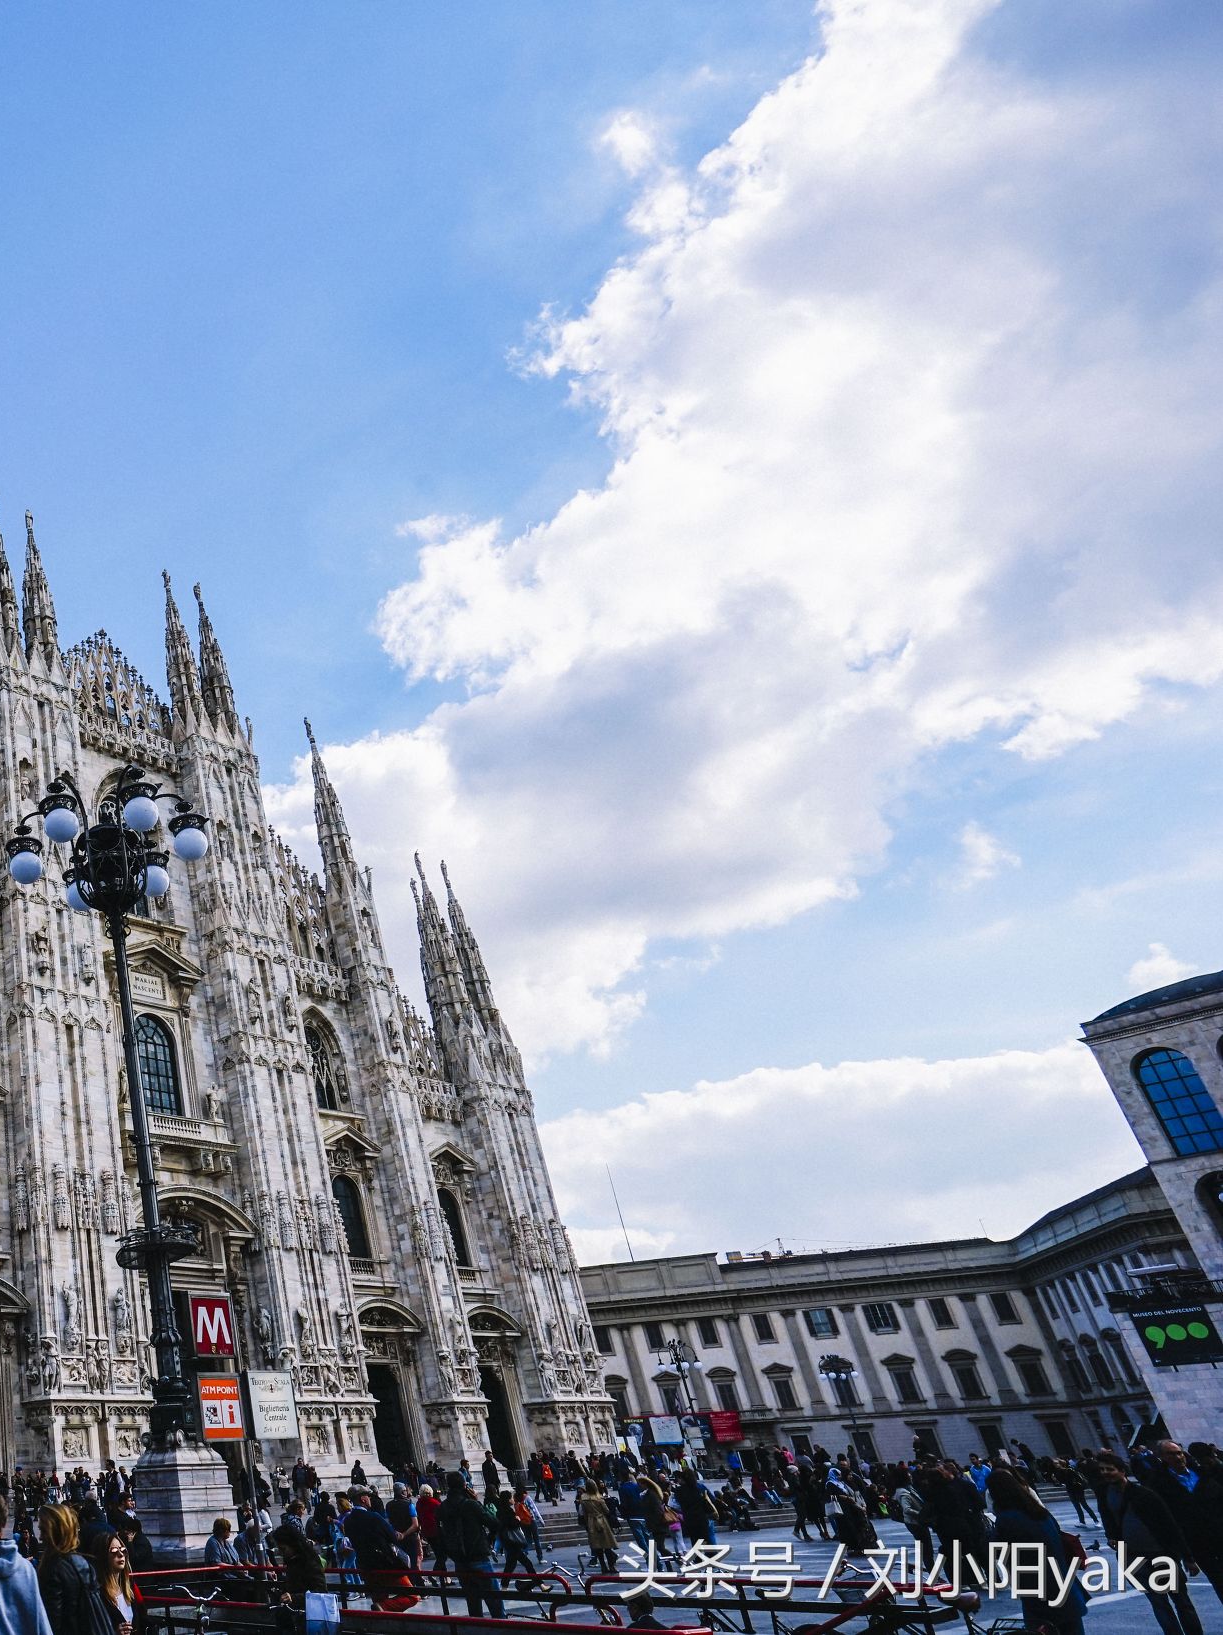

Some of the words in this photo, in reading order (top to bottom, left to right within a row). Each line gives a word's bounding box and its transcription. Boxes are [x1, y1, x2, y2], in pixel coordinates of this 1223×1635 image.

[134, 975, 157, 986] MARIAE
[133, 984, 162, 996] NASCENTI
[1166, 1306, 1202, 1314] NOVECENTO
[196, 1306, 232, 1344] M
[1144, 1322, 1209, 1349] 900
[201, 1386, 216, 1394] ATM
[216, 1386, 238, 1394] POINT
[264, 1414, 287, 1422] Centrale
